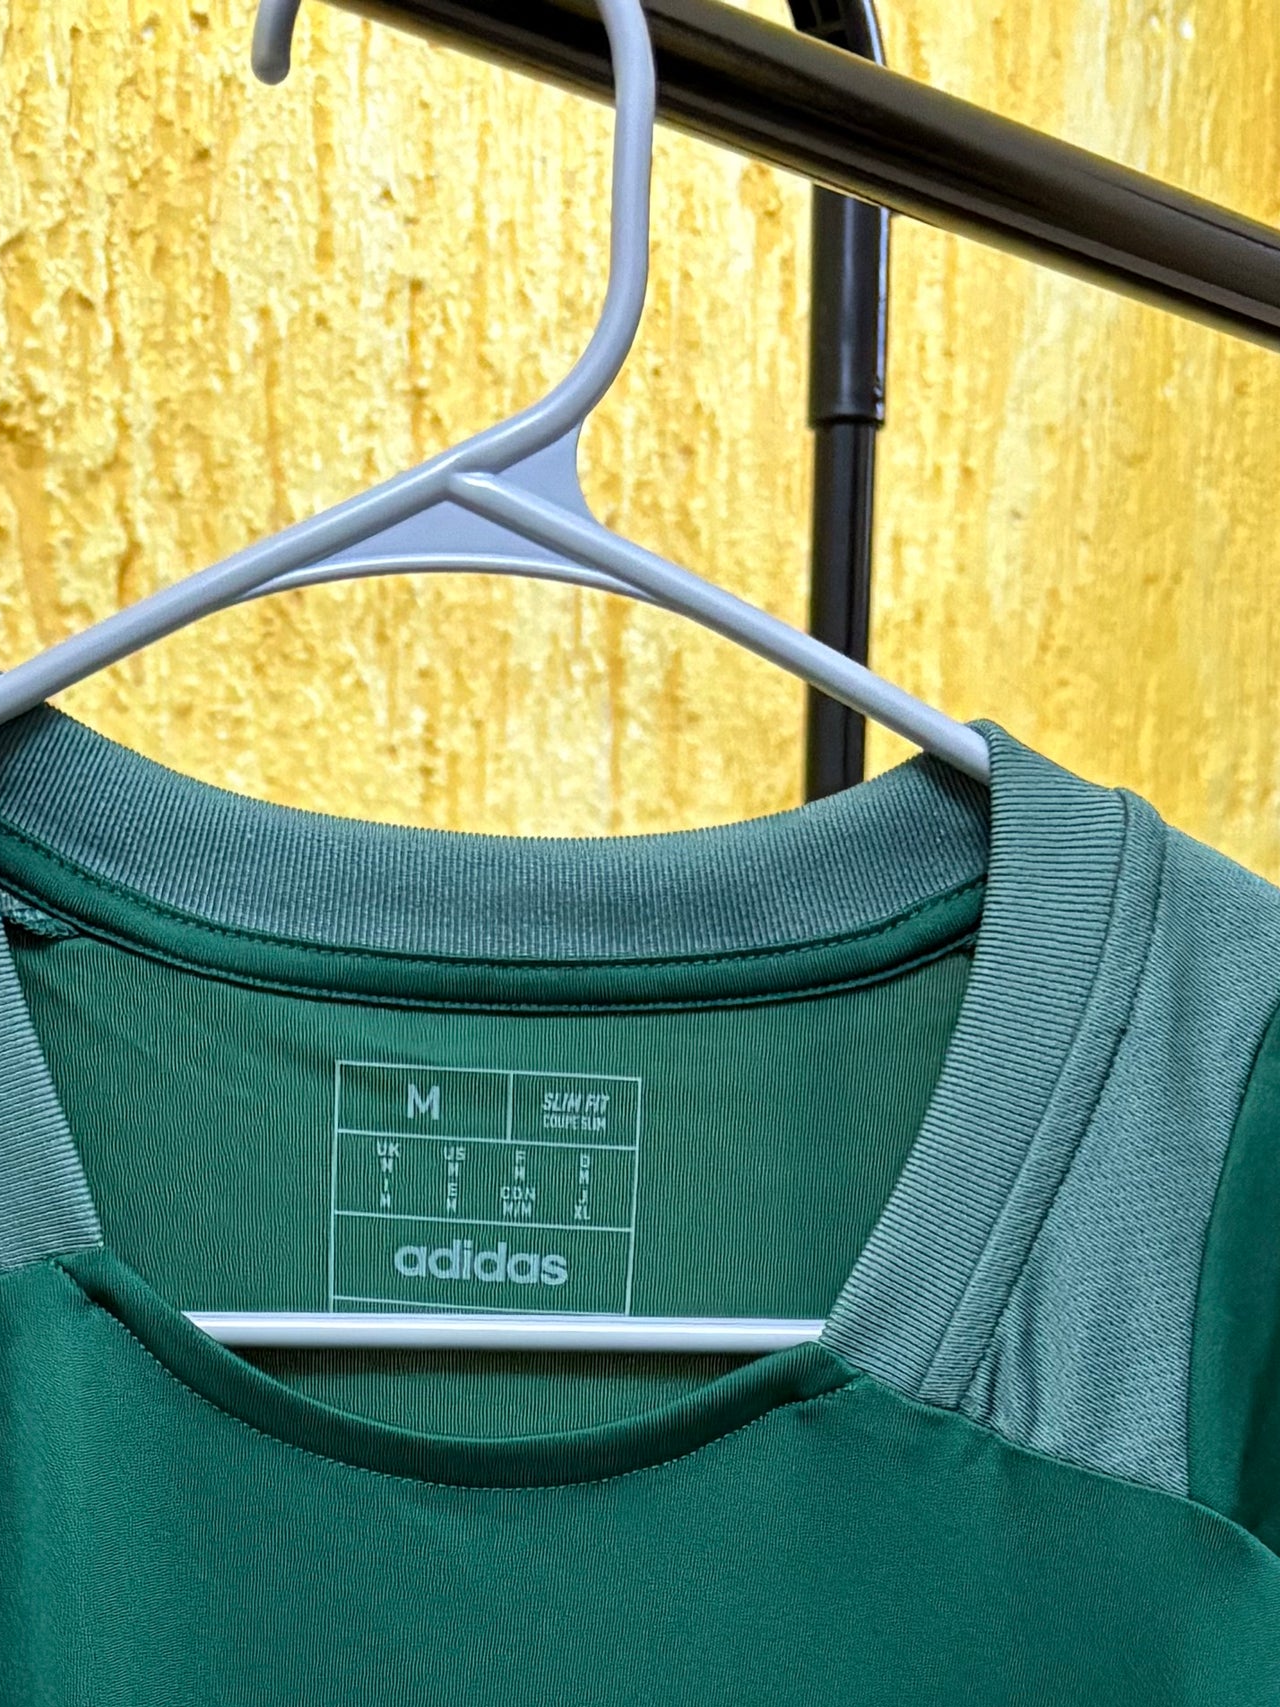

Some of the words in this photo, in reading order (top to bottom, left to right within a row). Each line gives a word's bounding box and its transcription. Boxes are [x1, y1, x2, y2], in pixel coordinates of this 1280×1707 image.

[407, 1084, 440, 1120] M
[542, 1092, 581, 1113] SLIM
[376, 1140, 400, 1157] UK
[394, 1239, 569, 1286] adidas
